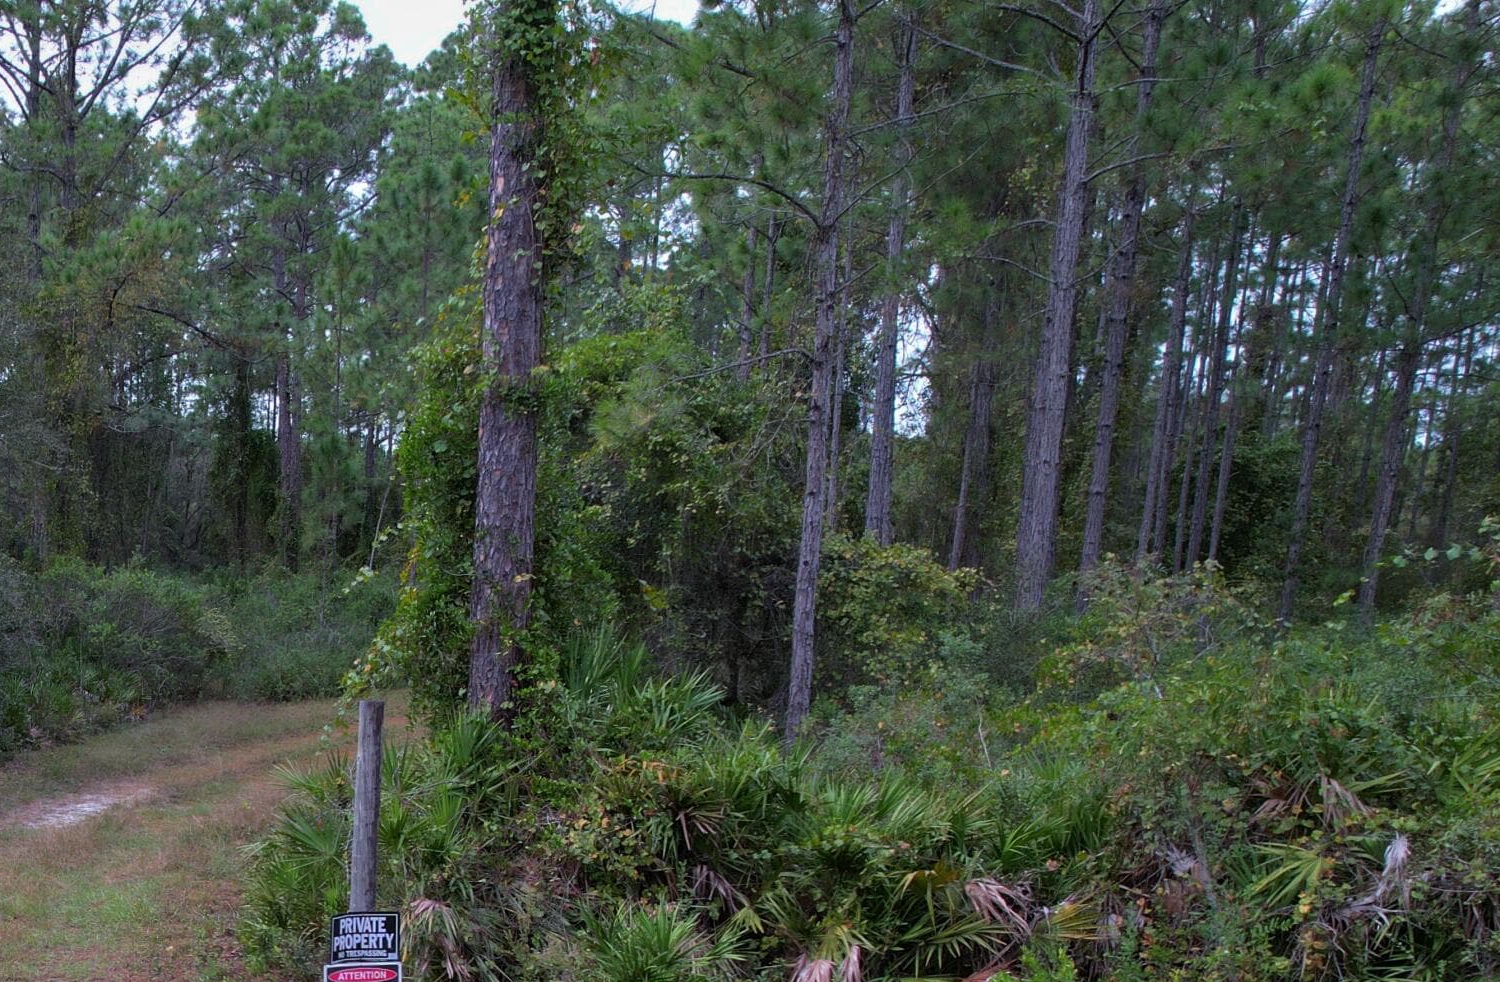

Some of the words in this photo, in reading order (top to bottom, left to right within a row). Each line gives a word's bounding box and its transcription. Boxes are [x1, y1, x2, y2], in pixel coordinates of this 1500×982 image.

[340, 916, 387, 934] PRIVATE
[334, 933, 394, 952] PROPERTY
[345, 949, 388, 958] TRESPASSING
[338, 971, 387, 981] ATTENTION
